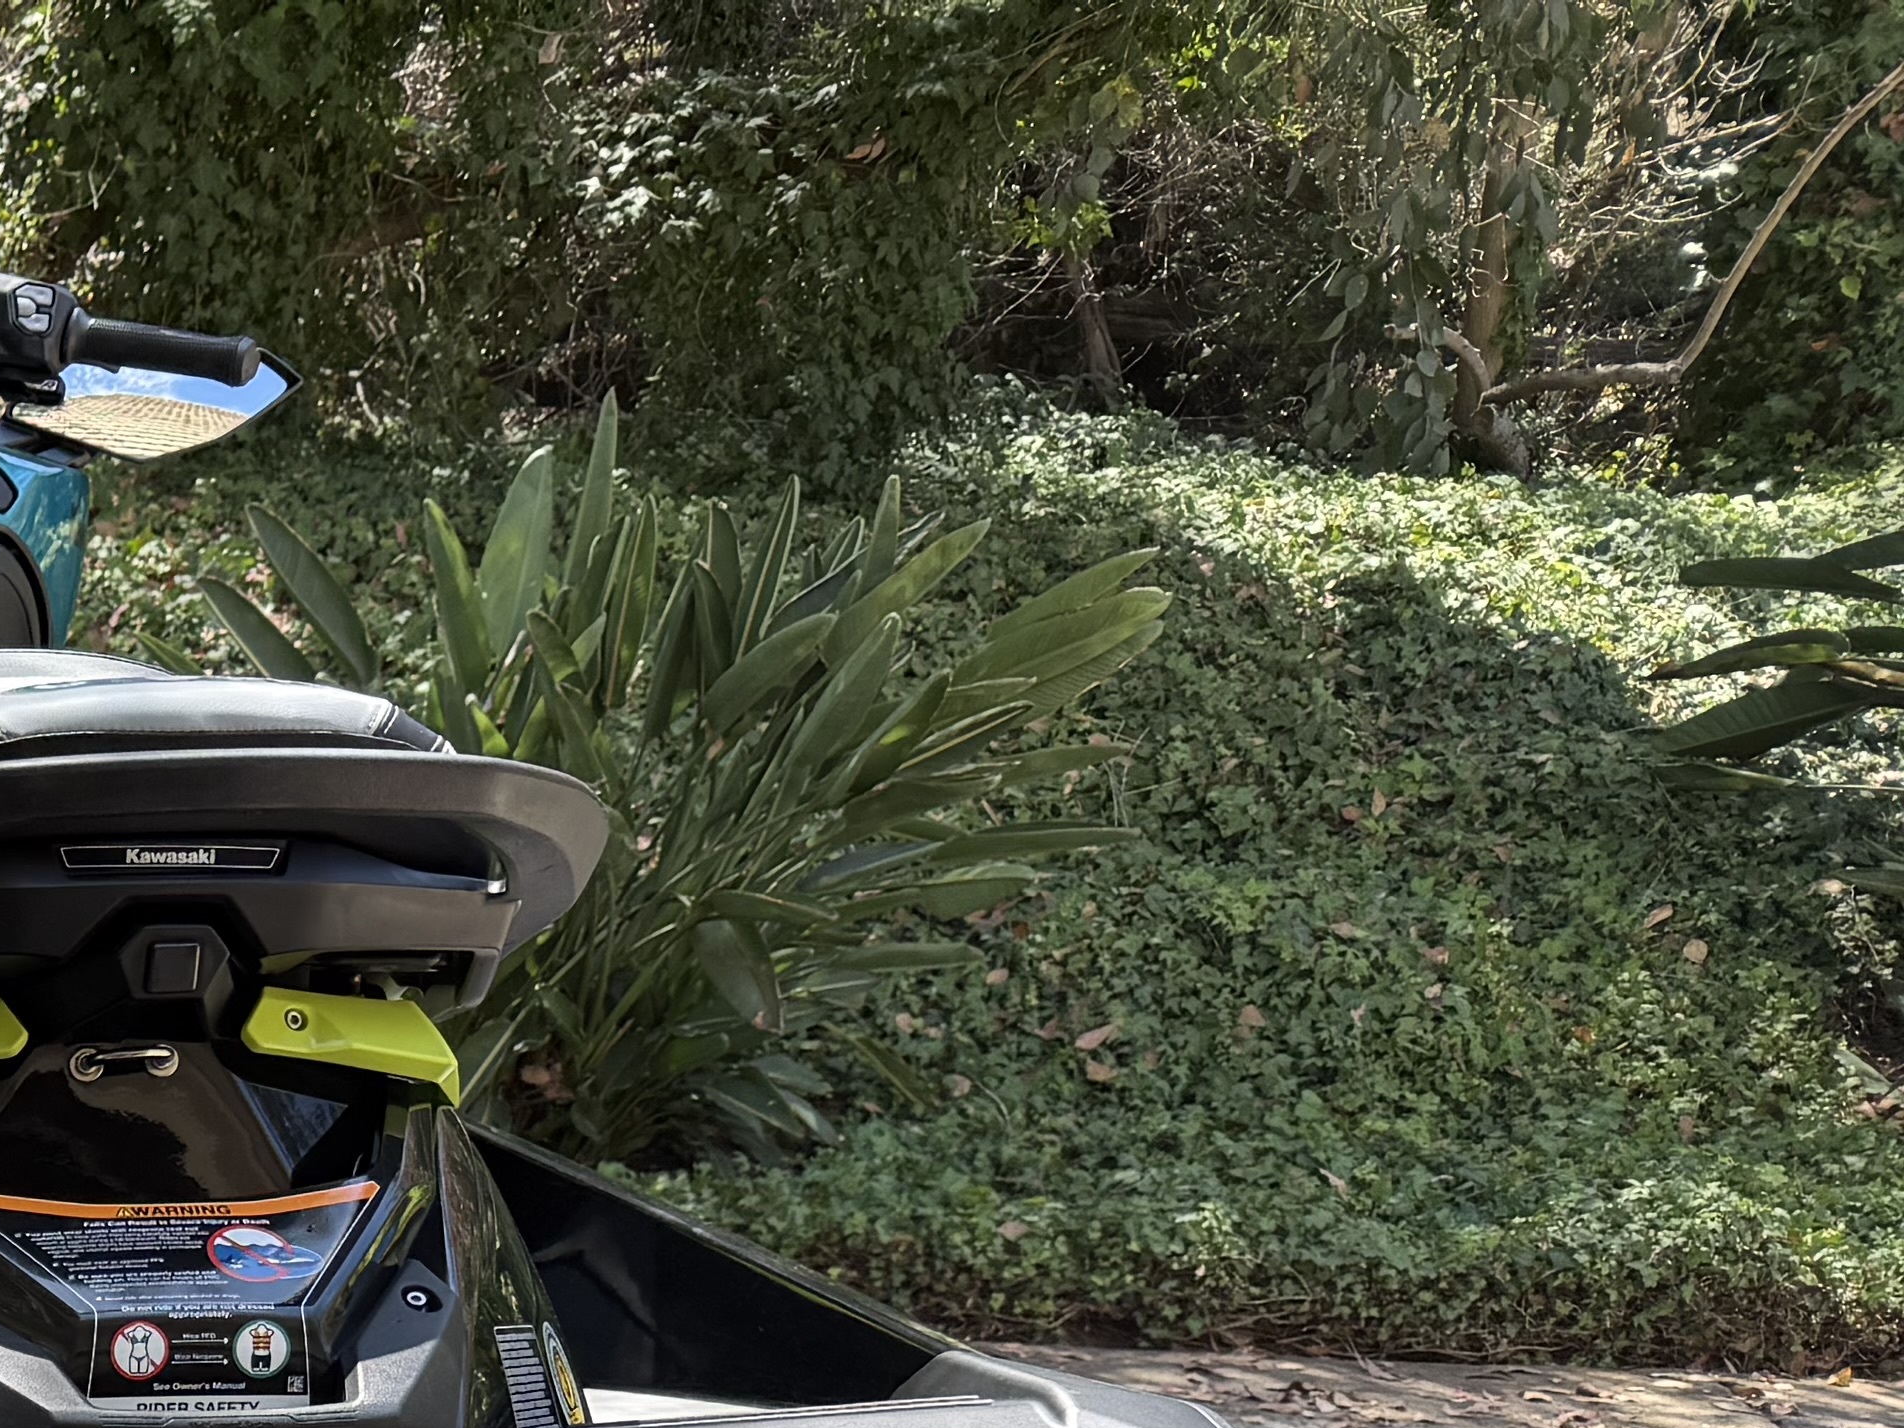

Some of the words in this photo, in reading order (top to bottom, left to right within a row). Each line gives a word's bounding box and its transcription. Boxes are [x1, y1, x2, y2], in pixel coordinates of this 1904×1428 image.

[125, 848, 216, 864] Kawasaki
[133, 1204, 232, 1217] WARNING
[172, 1382, 210, 1390] Owner's
[212, 1382, 246, 1390] Manual
